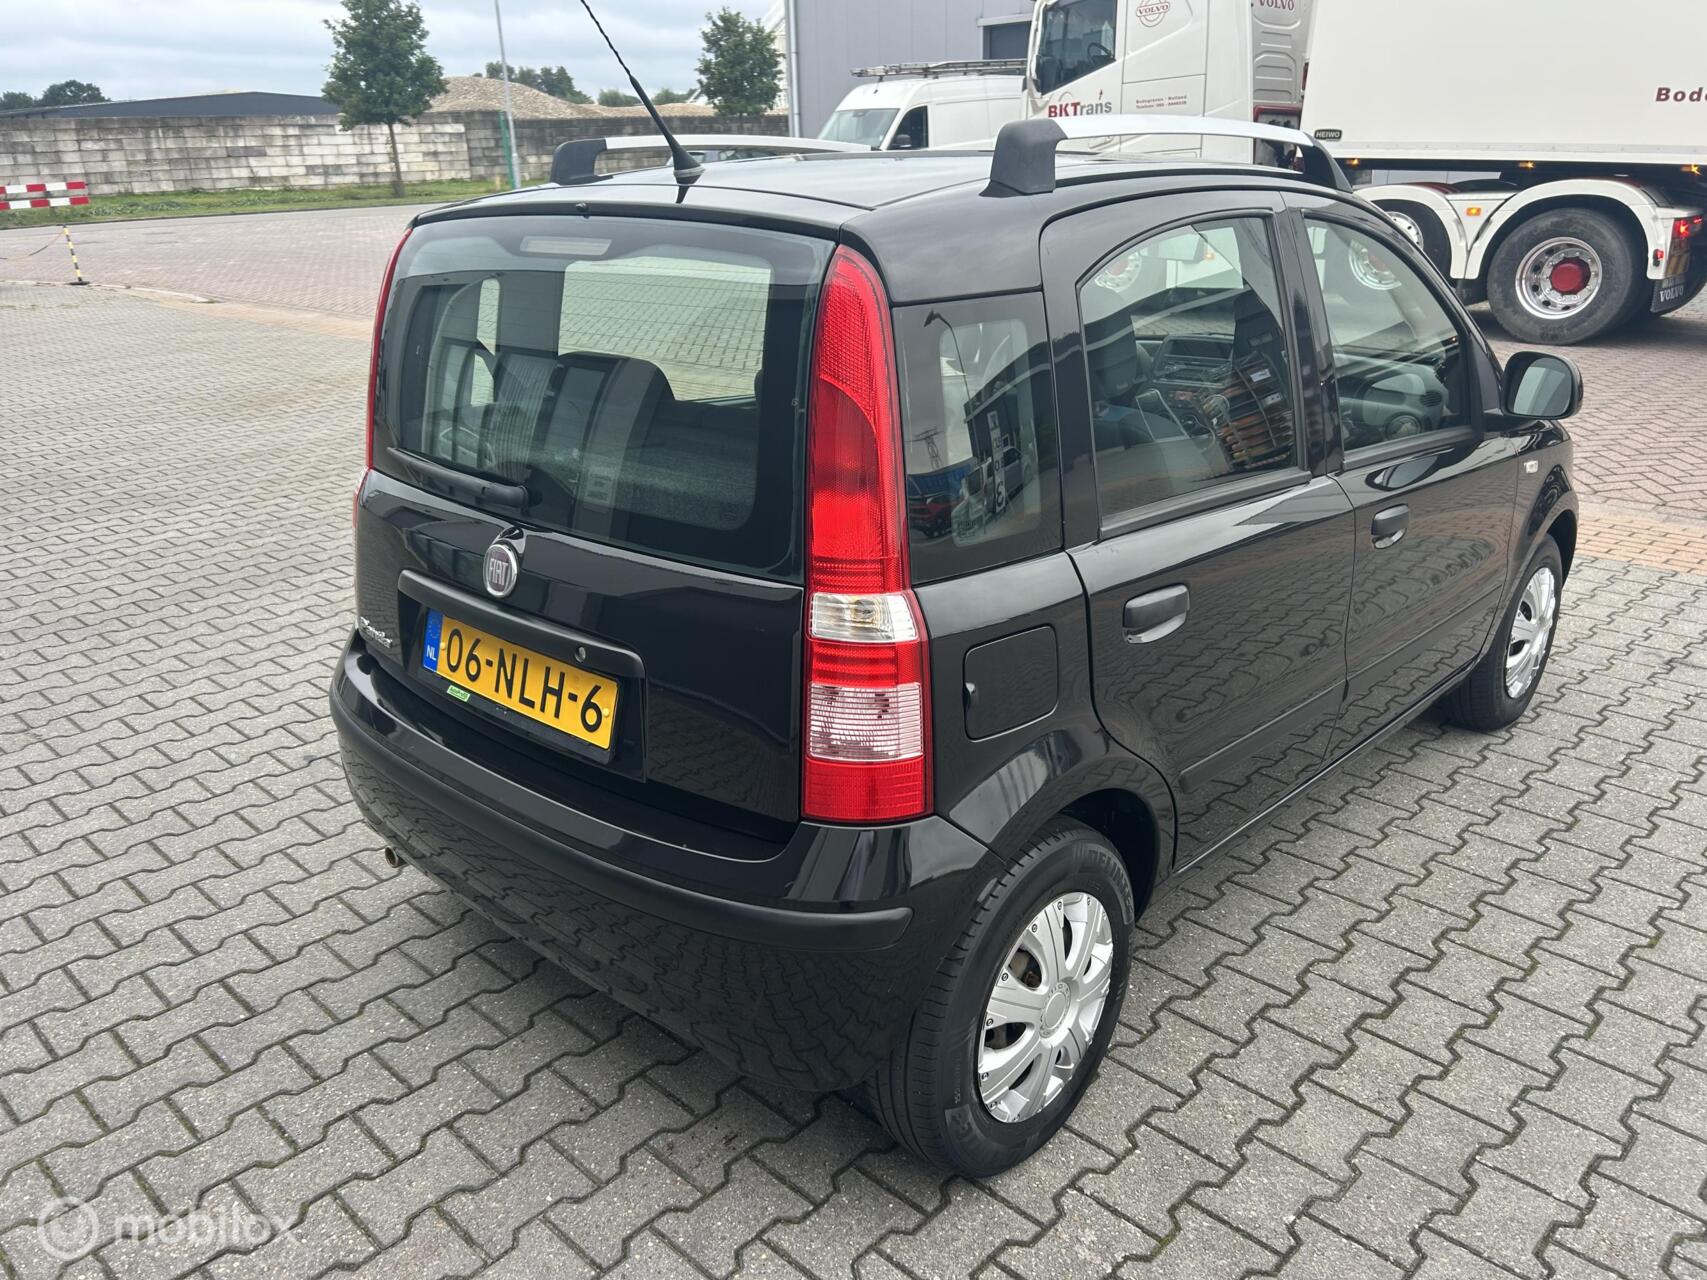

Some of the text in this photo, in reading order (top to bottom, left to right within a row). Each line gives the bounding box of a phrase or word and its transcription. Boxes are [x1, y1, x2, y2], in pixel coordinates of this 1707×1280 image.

[1137, 4, 1169, 16] VOLVO
[1258, 0, 1294, 11] VOLVO
[1656, 86, 1707, 102] Bod
[1048, 101, 1112, 118] BKTrans
[1660, 284, 1684, 302] VOLVO
[489, 558, 509, 585] FIAT
[426, 645, 437, 661] NL
[446, 628, 602, 733] 06-NLH-6
